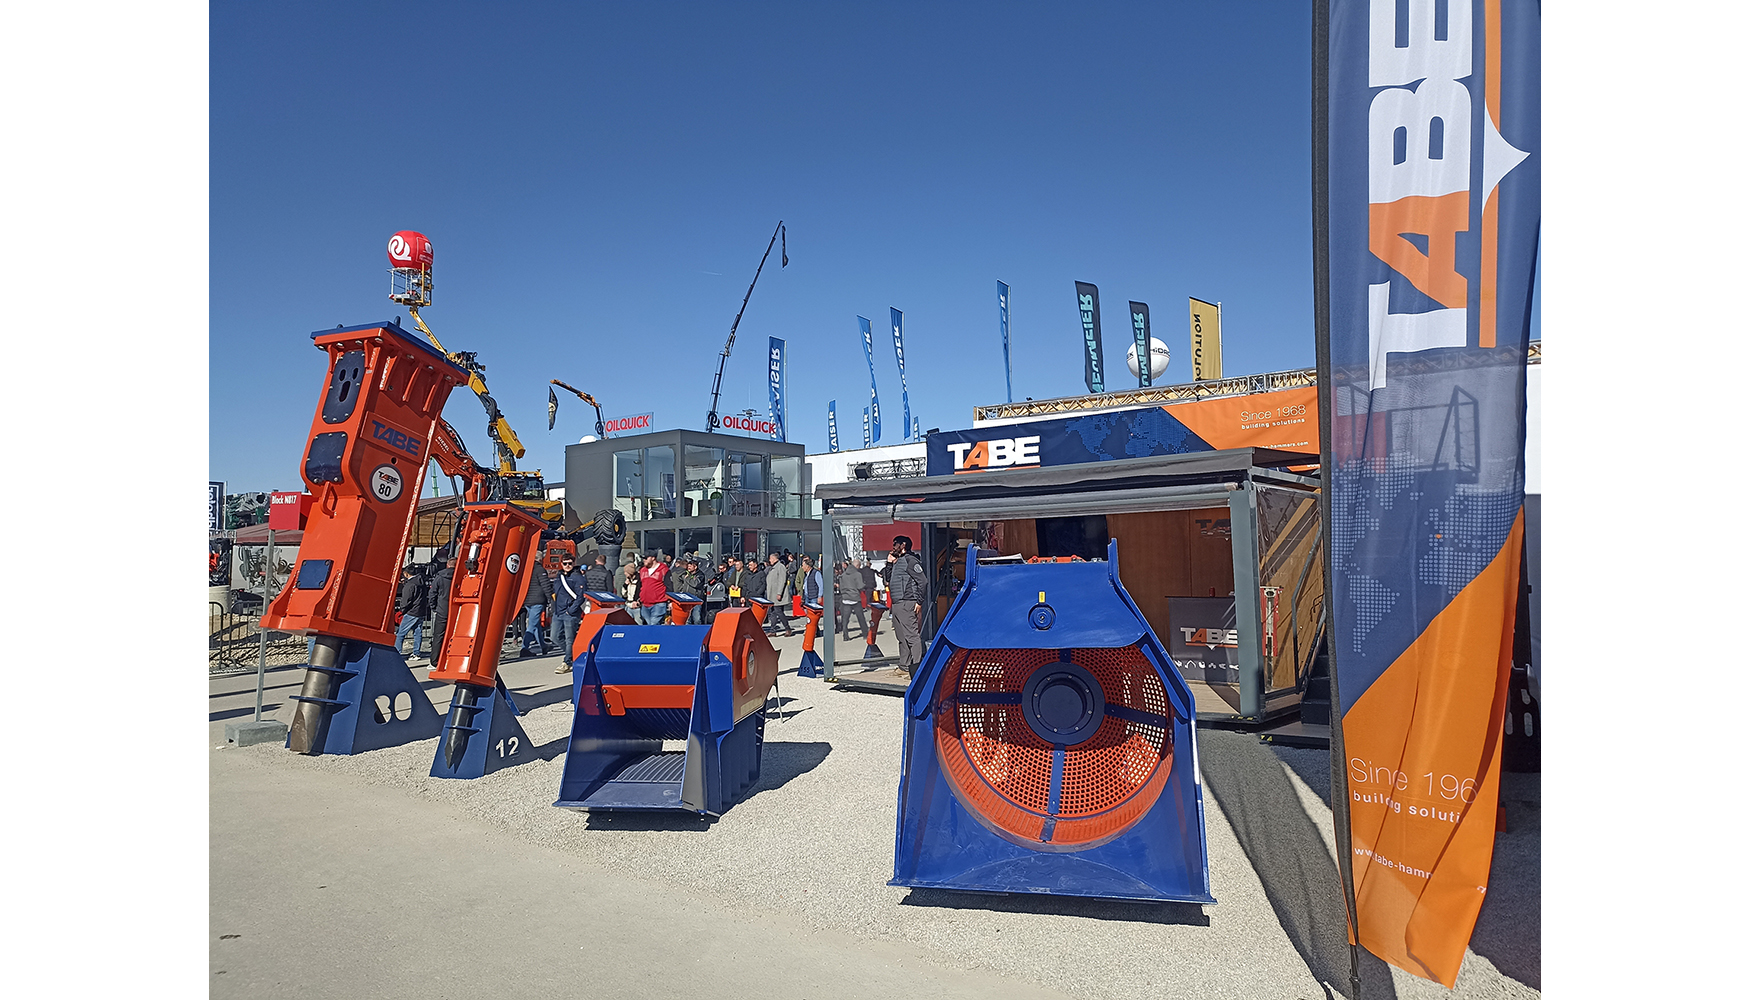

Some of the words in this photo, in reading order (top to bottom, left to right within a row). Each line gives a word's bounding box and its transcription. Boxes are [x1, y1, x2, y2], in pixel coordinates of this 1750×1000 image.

[1368, 0, 1472, 391] TABE
[1241, 411, 1272, 422] Since
[1276, 404, 1306, 418] 1968
[605, 415, 650, 433] OILQUICK
[722, 415, 776, 434] OILQUICK
[1241, 421, 1270, 430] building
[1272, 418, 1305, 427] solutions
[371, 420, 422, 457] TABE
[947, 435, 1041, 470] TABE
[378, 470, 399, 484] TABE
[378, 483, 391, 497] 80
[271, 495, 284, 504] Block
[1180, 627, 1238, 645] TABE
[373, 691, 412, 725] 80
[495, 736, 519, 758] 12
